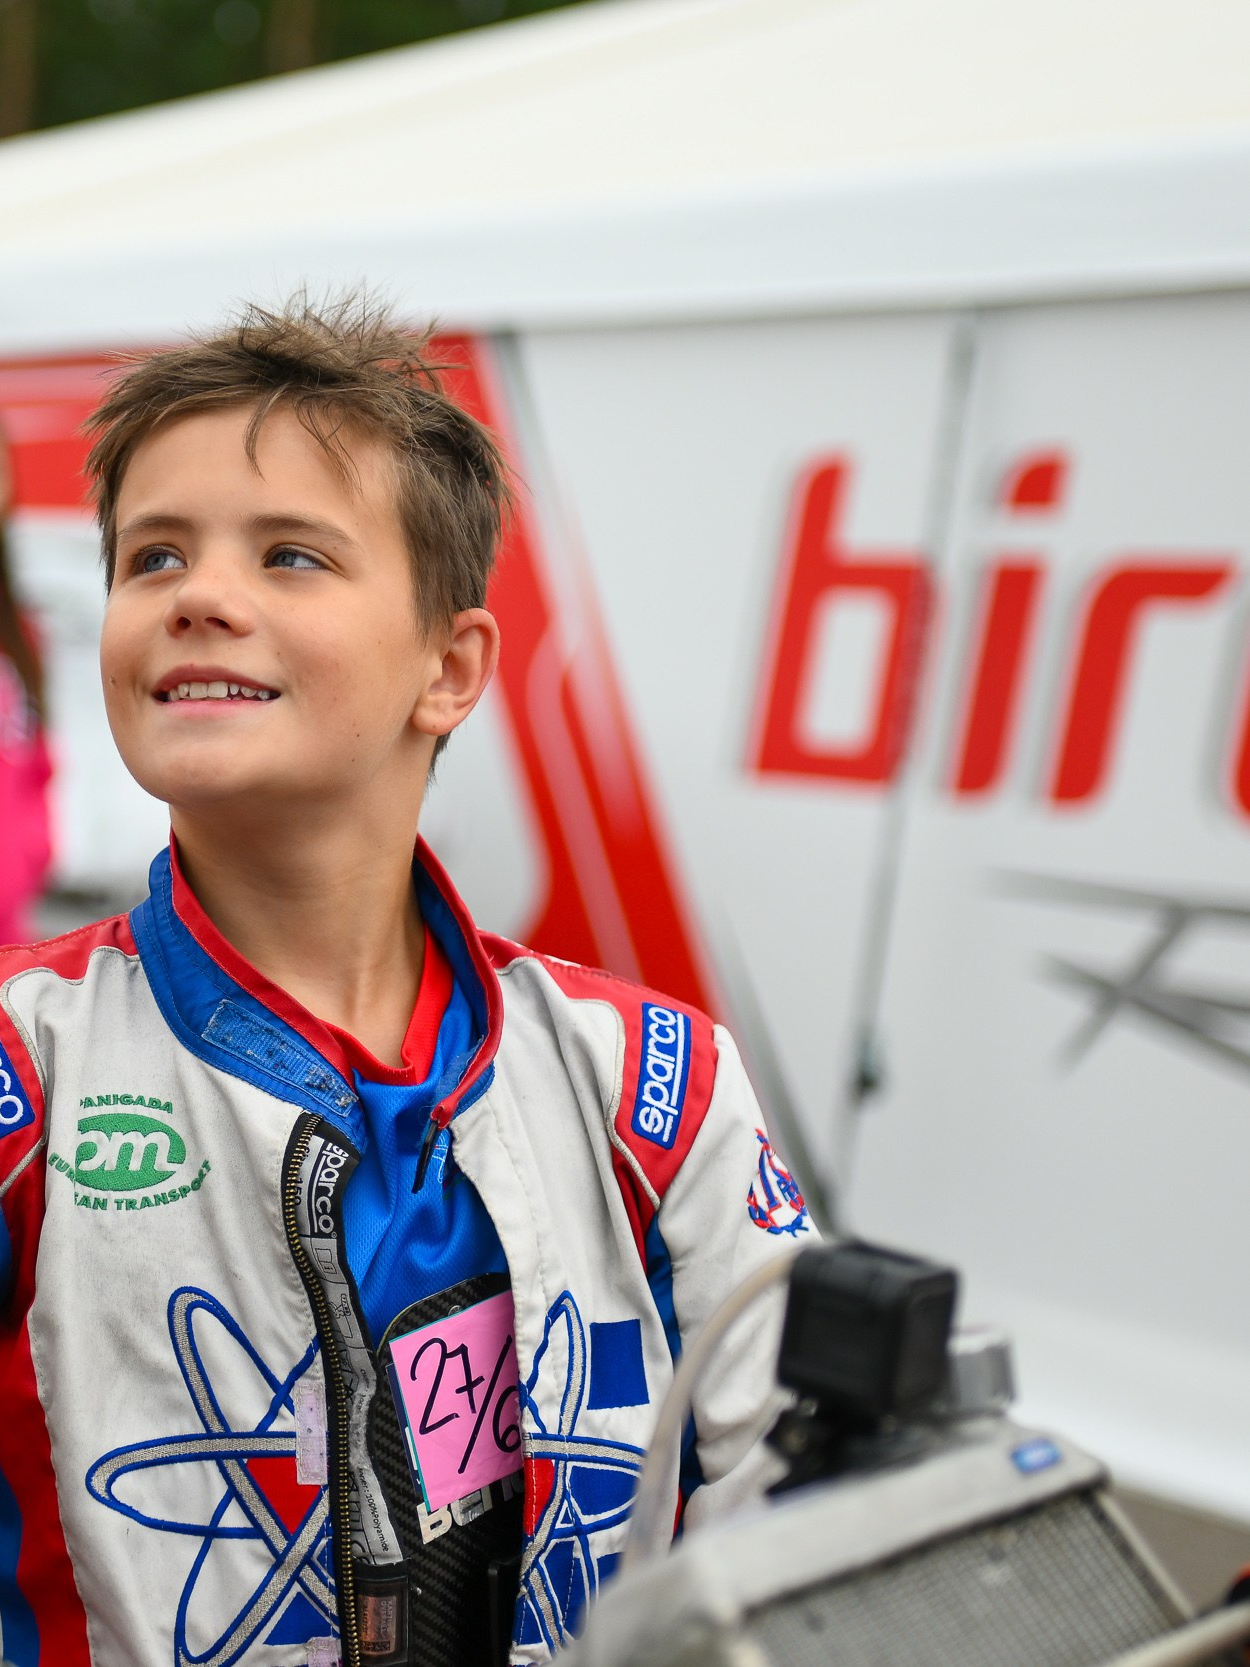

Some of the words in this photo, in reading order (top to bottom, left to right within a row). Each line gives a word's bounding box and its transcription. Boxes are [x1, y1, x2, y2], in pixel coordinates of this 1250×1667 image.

[746, 447, 1250, 830] bir
[80, 1093, 174, 1115] ANIGADA
[638, 1006, 680, 1136] sparco
[114, 1158, 212, 1211] TRANSPORT
[316, 1142, 350, 1234] sparco
[410, 1335, 521, 1475] 27/6
